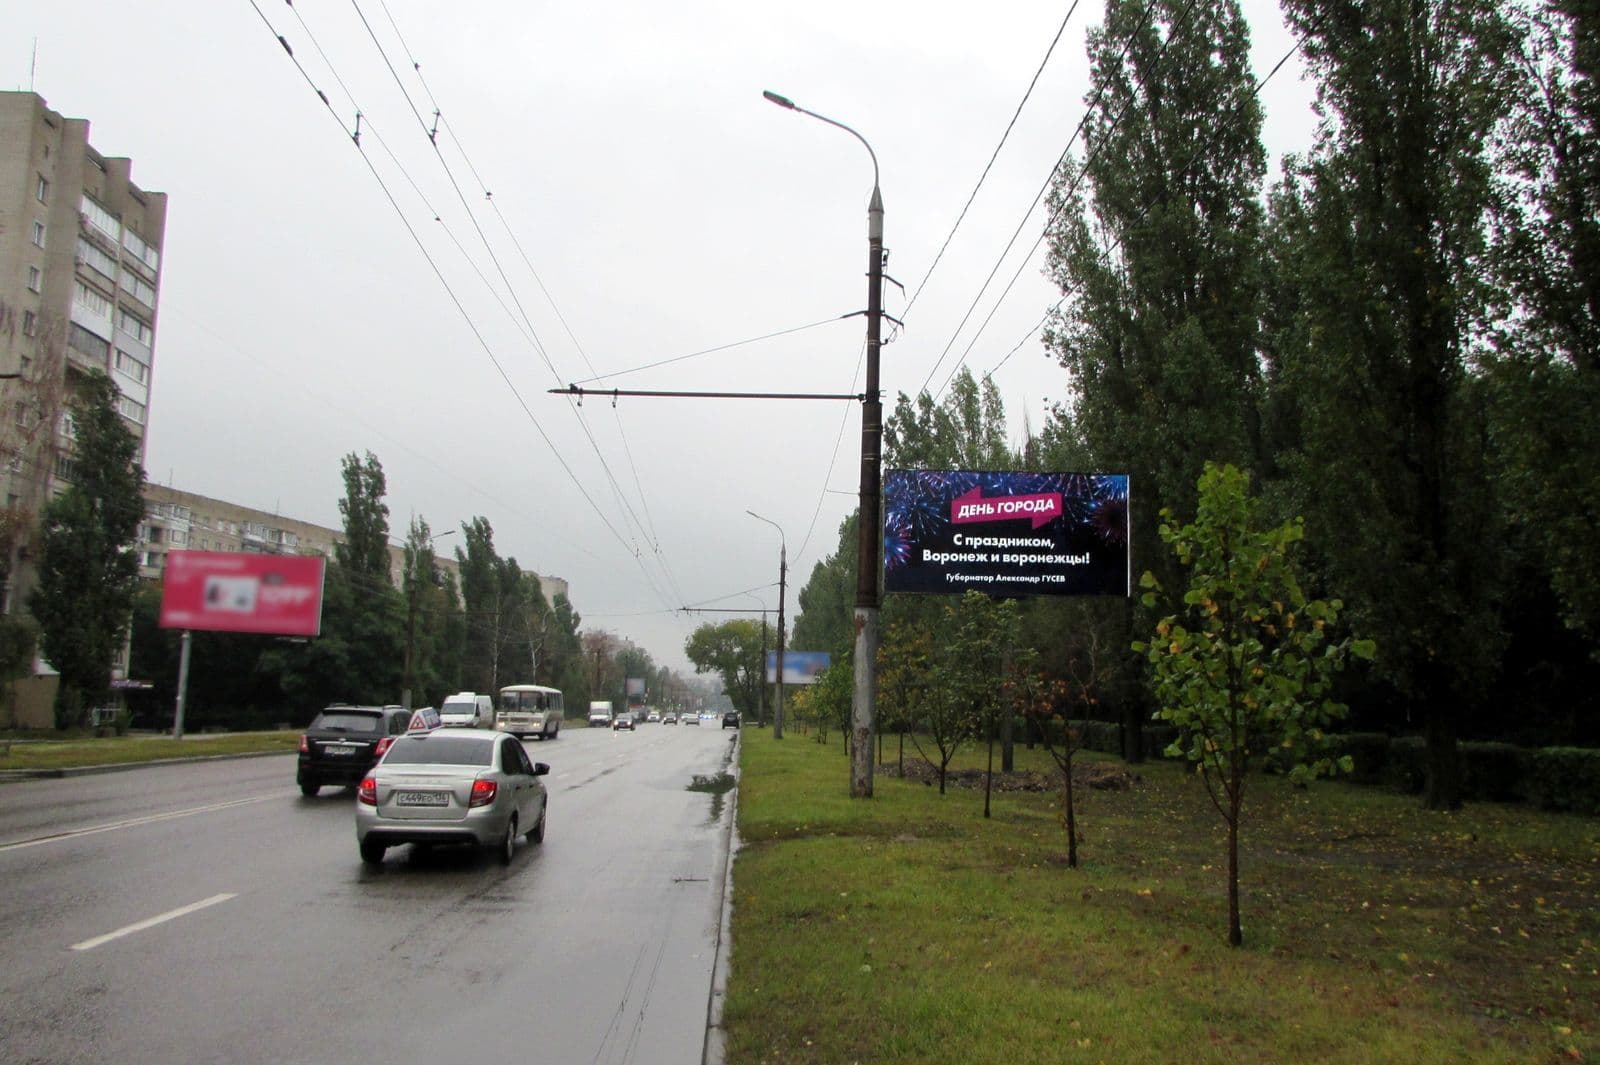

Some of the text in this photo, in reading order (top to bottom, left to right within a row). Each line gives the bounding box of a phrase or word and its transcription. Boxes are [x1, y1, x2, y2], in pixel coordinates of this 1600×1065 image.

[958, 499, 1055, 518] ДЕНЬ ГОРОДА
[953, 534, 1055, 549] С праздником,
[923, 549, 1090, 566] Воронеж и воронежцы!
[946, 573, 994, 582] Губернатор
[995, 574, 1040, 583] Александр
